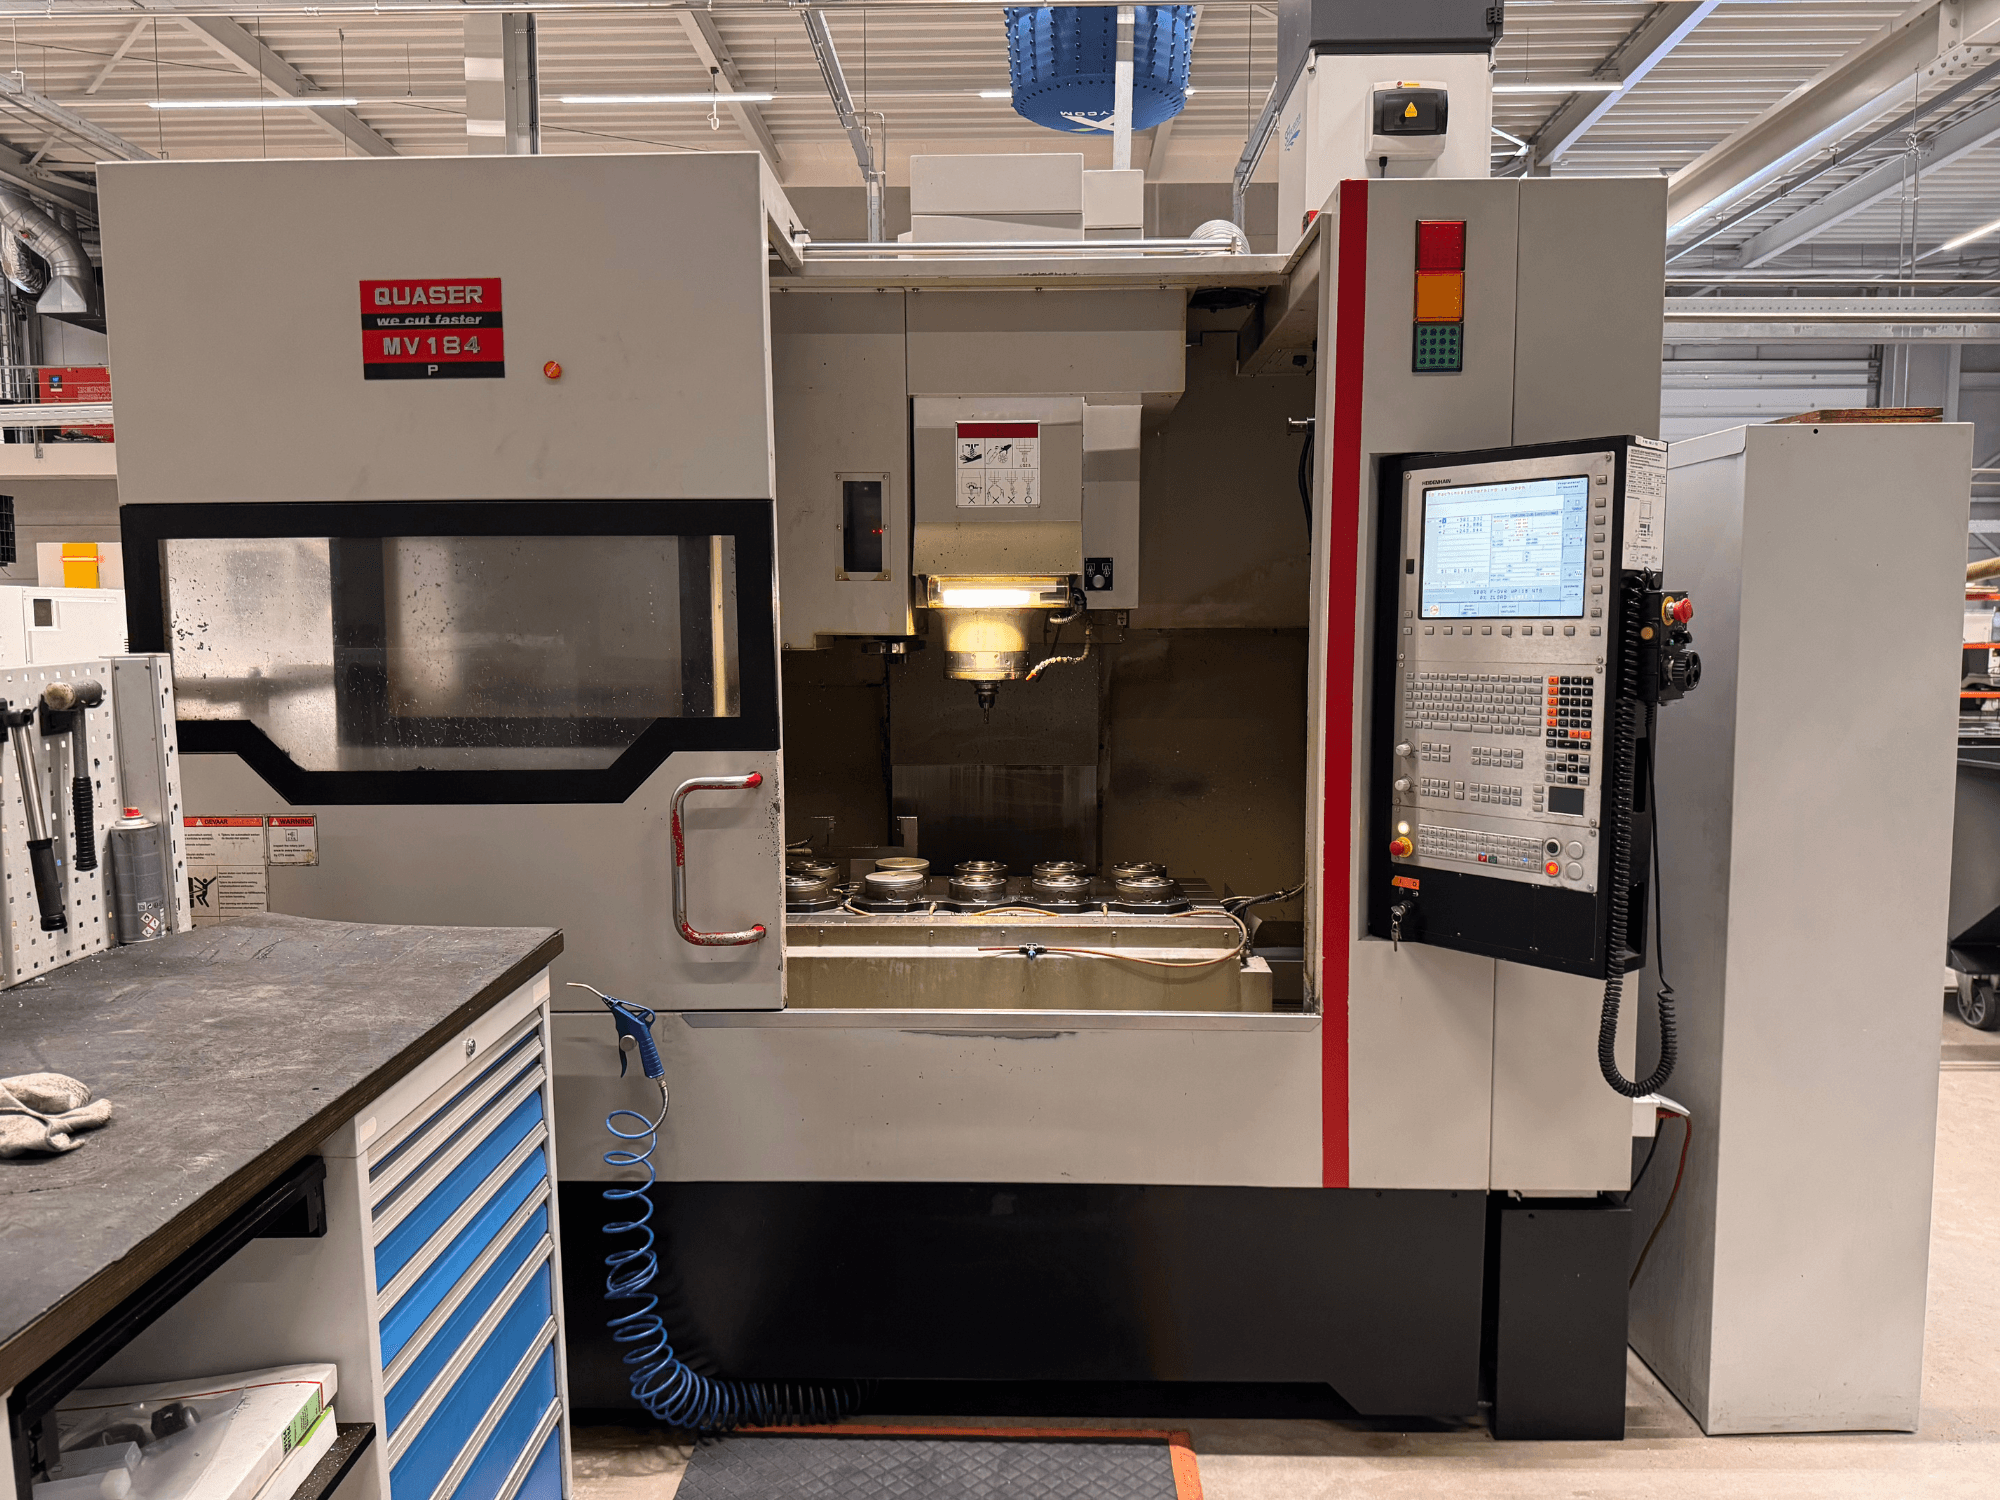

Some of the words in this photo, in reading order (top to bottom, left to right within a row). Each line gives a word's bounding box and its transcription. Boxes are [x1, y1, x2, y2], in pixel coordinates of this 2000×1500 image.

[374, 286, 483, 306] QUASER
[377, 317, 400, 326] we
[405, 315, 431, 325] cut
[434, 314, 482, 325] faster
[427, 364, 439, 376] P
